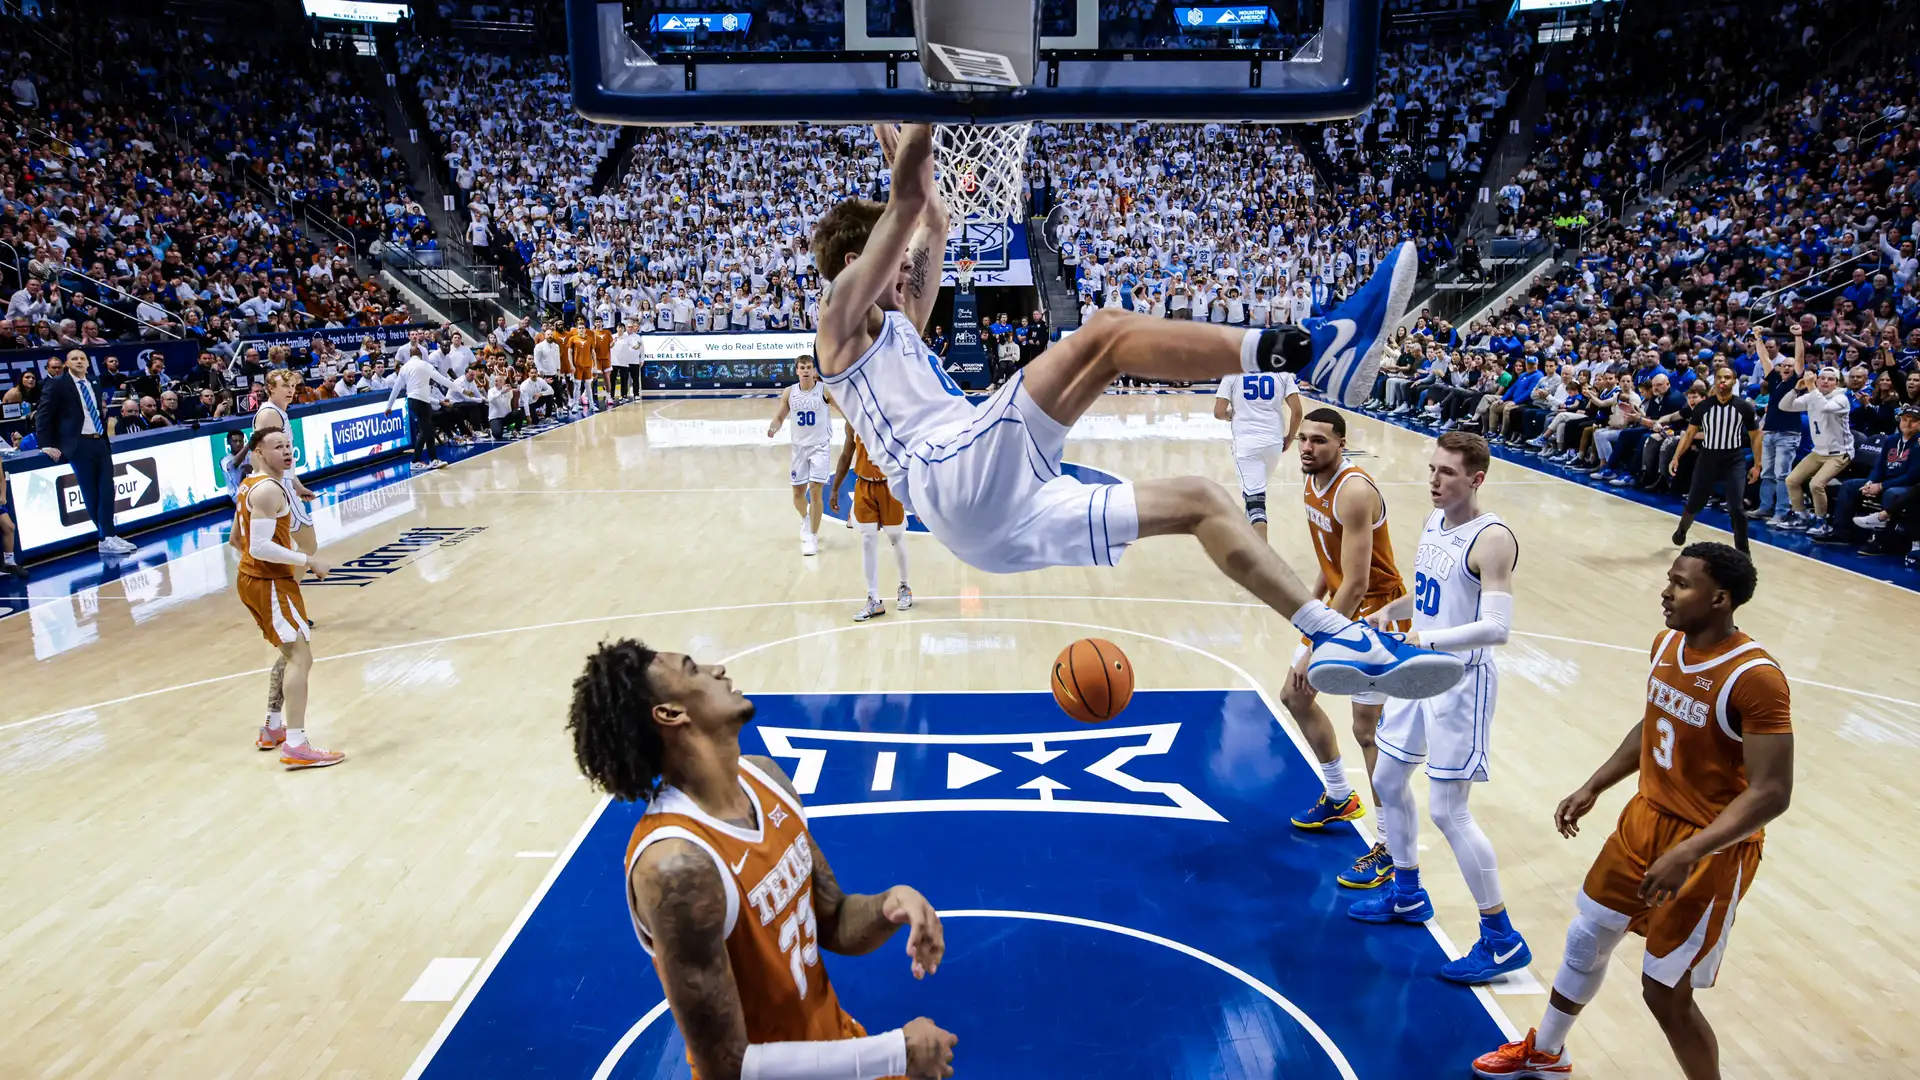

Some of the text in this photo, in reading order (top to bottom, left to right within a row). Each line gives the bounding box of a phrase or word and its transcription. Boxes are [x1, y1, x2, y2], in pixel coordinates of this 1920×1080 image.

[706, 343, 720, 351] We
[722, 343, 733, 351] do
[736, 342, 754, 351] Real
[757, 342, 784, 351] Estate
[786, 341, 805, 350] with
[1243, 375, 1275, 400] 50
[335, 416, 402, 445] visitBYU.com
[797, 411, 815, 426] 30
[114, 480, 138, 498] our
[299, 526, 467, 587] Marriott
[1317, 529, 1332, 562] 1
[1414, 543, 1456, 581] BYU
[1415, 571, 1441, 617] 20
[1647, 676, 1710, 728] TEXAS
[1652, 717, 1675, 771] 3
[747, 831, 813, 926] TEXAS
